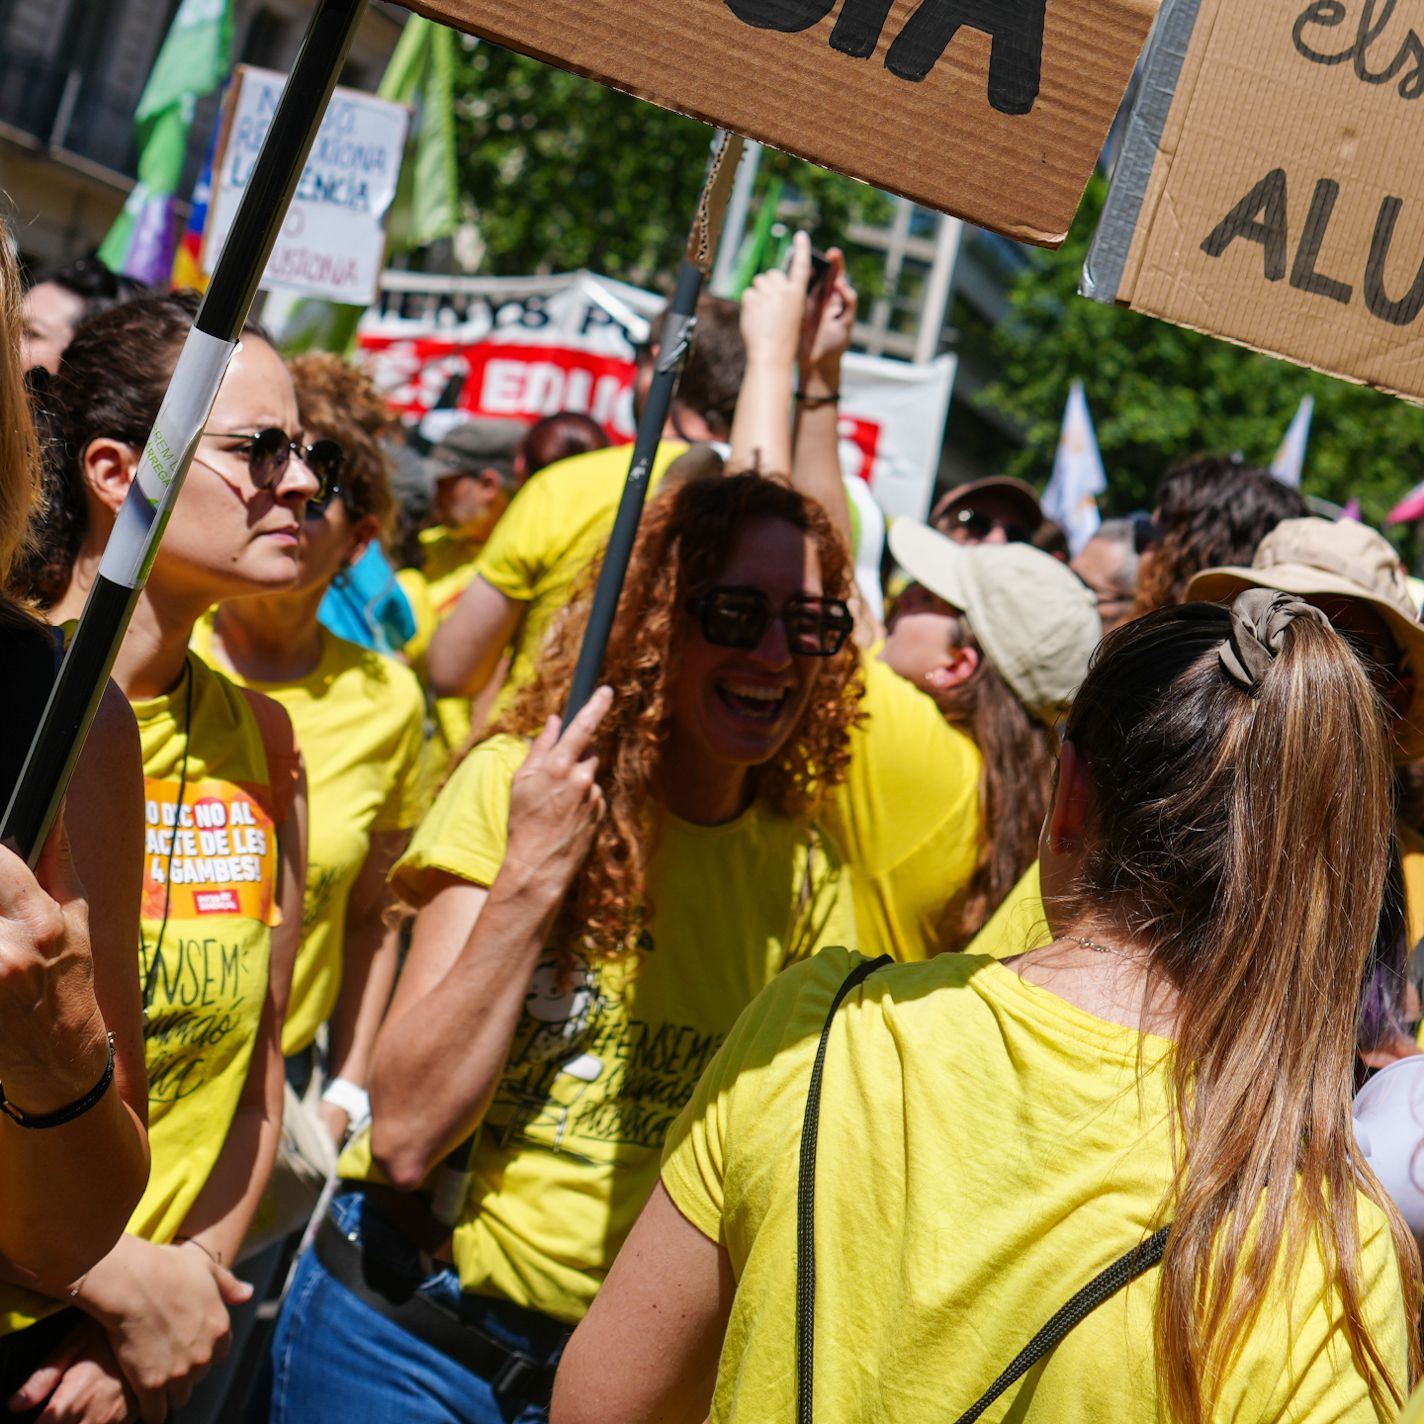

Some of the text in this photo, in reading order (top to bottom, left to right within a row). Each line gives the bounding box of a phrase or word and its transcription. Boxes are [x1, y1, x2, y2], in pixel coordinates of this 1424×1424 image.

[194, 802, 227, 828] NO
[230, 801, 257, 825] AL
[145, 828, 267, 856] ACTE DE LES
[151, 857, 262, 884] 4 GAMBES!
